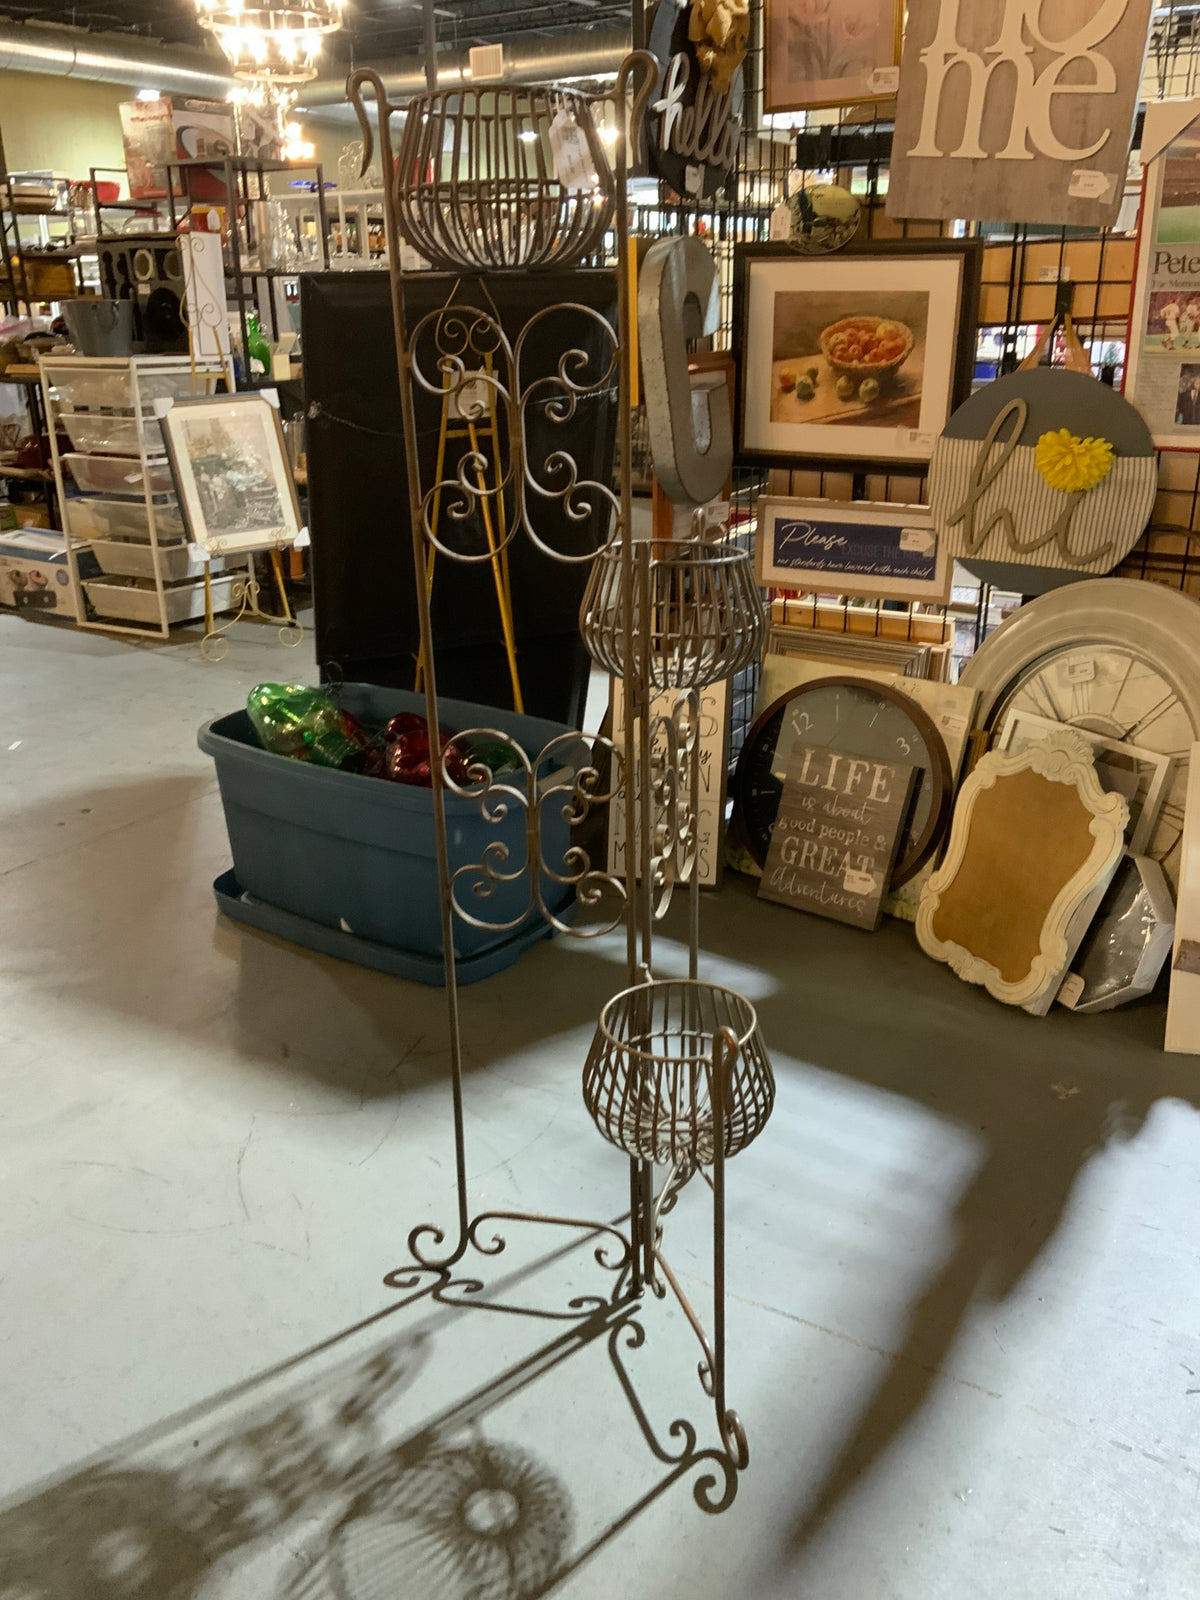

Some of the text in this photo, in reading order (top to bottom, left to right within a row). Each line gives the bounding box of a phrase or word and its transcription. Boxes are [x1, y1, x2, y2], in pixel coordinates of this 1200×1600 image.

[652, 52, 743, 169] hello
[906, 51, 1117, 160] me
[945, 398, 1113, 565] hi
[779, 521, 848, 551] Please
[790, 557, 825, 570] standards
[827, 559, 843, 569] have
[844, 561, 877, 573] lowered
[874, 564, 892, 574] with
[893, 566, 909, 575] each
[910, 567, 933, 578] child
[792, 711, 814, 736] 12
[896, 737, 911, 756] 3
[797, 747, 896, 803] LIFE
[802, 794, 873, 826] is about
[778, 817, 888, 852] good people &
[780, 836, 875, 878] GREAT
